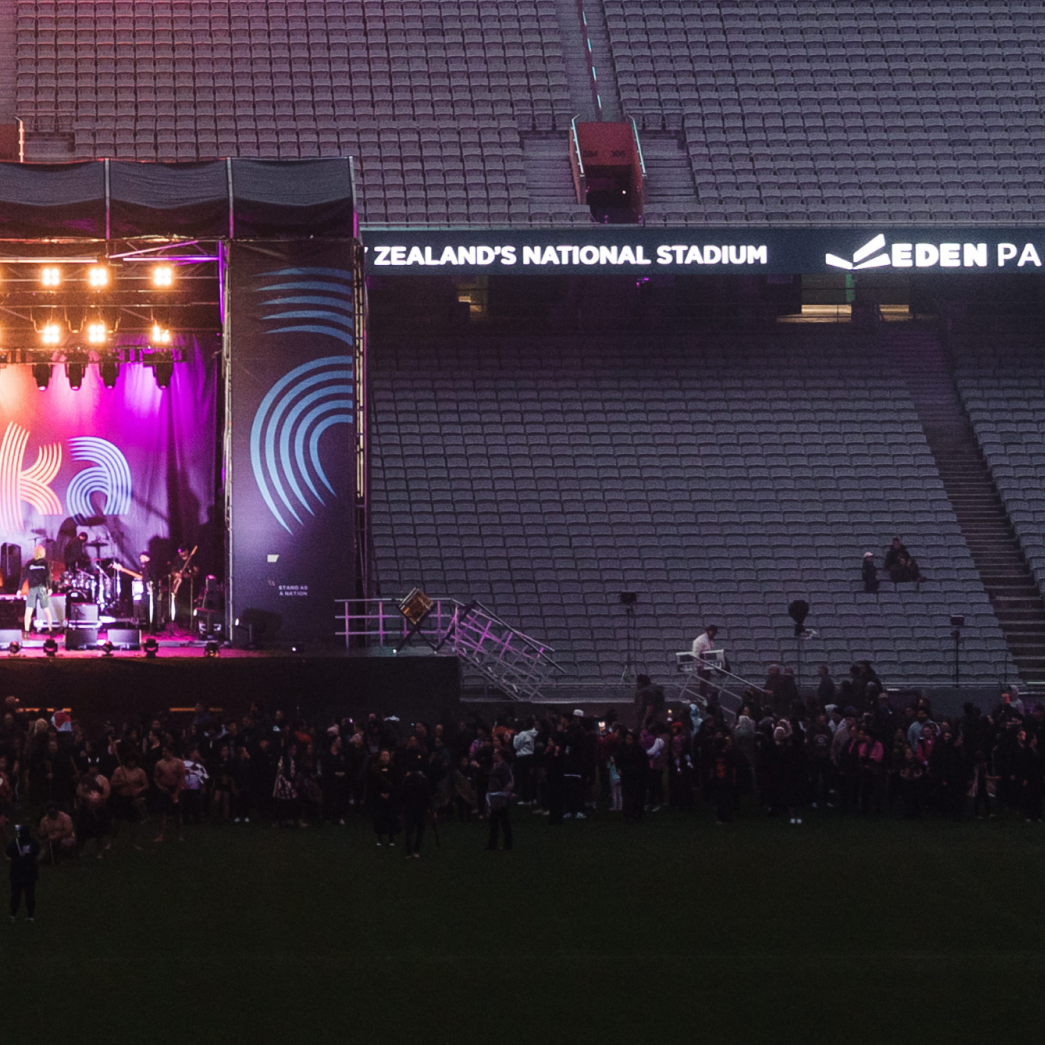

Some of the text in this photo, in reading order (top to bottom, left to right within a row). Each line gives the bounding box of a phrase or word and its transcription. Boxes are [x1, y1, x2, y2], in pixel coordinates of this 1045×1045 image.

[374, 246, 516, 265] ZEALAND'S
[523, 246, 651, 264] NATIONAL
[657, 245, 767, 264] STADIUM
[892, 243, 987, 267] EDEN
